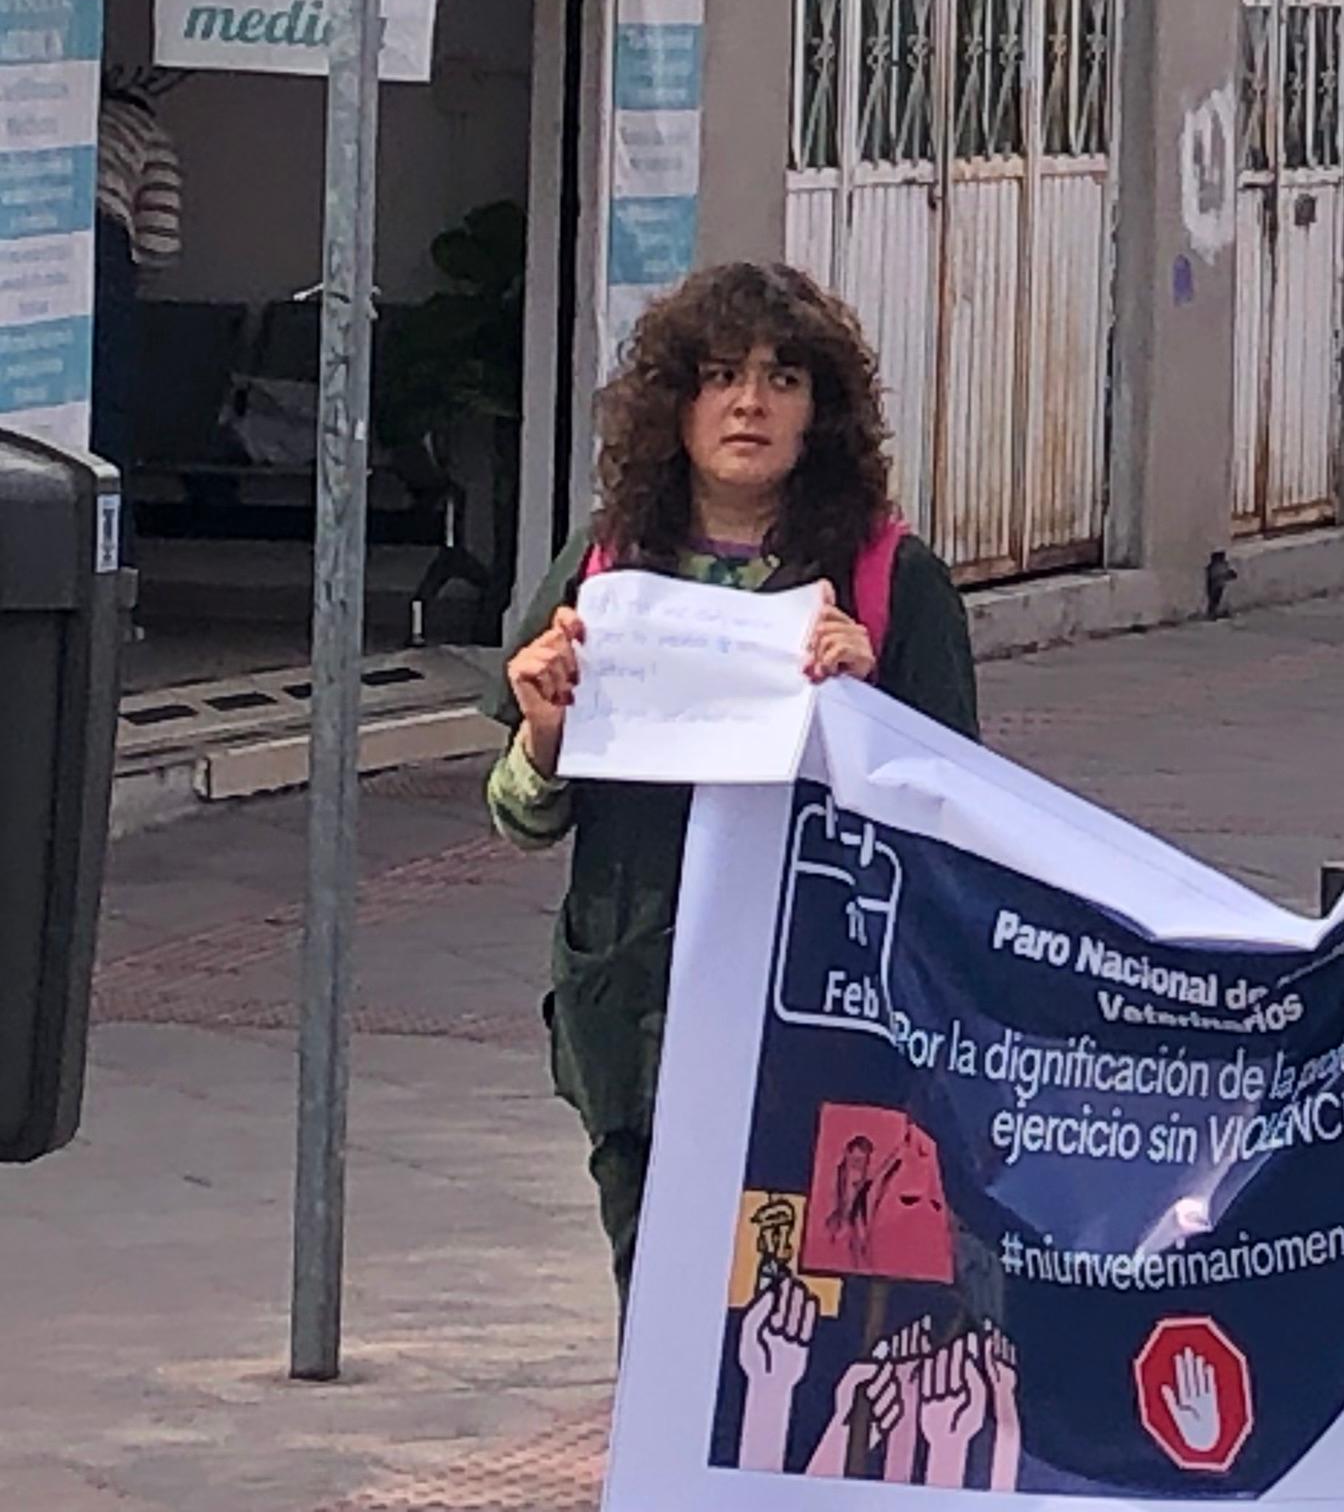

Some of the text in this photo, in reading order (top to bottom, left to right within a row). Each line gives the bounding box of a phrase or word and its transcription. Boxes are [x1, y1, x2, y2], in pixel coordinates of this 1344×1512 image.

[823, 969, 880, 1019] Feb
[992, 908, 1071, 967] Paro
[1074, 935, 1218, 1009] Nacional
[891, 1010, 946, 1070] Por
[948, 1019, 977, 1078] la
[984, 1028, 1210, 1101] dignificación
[1218, 1046, 1266, 1101] de
[992, 1100, 1142, 1166] ejercicio
[1147, 1112, 1198, 1165] sin
